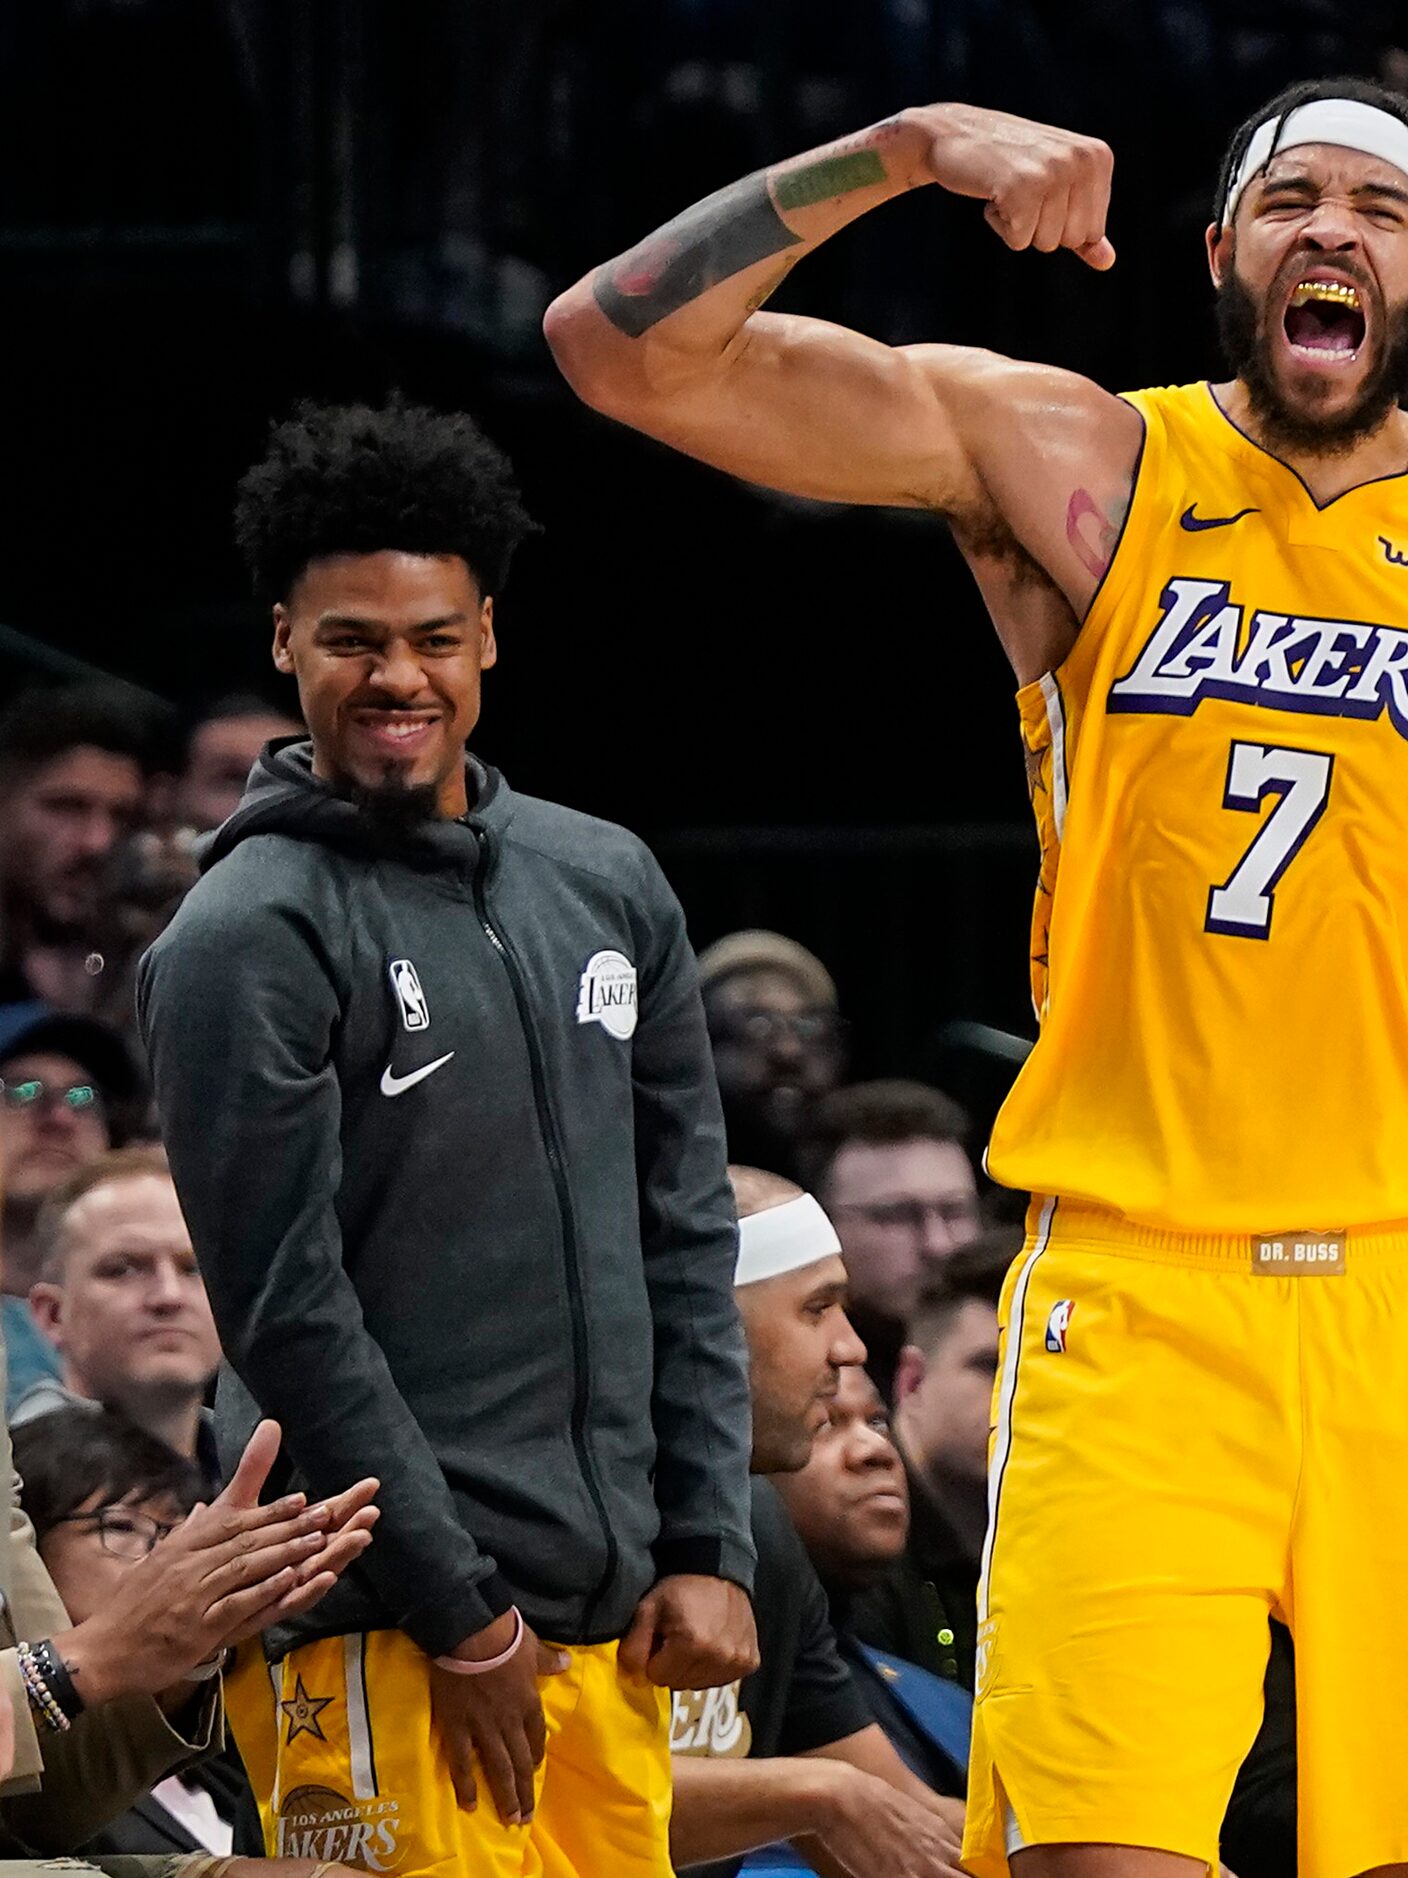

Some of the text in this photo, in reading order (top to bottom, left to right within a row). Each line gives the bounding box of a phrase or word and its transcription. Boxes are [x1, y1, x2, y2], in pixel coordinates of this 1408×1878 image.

[1203, 739, 1335, 941] 7
[1260, 1242, 1339, 1262] DR. BUSS
[292, 1799, 399, 1828] LOS ANGELES
